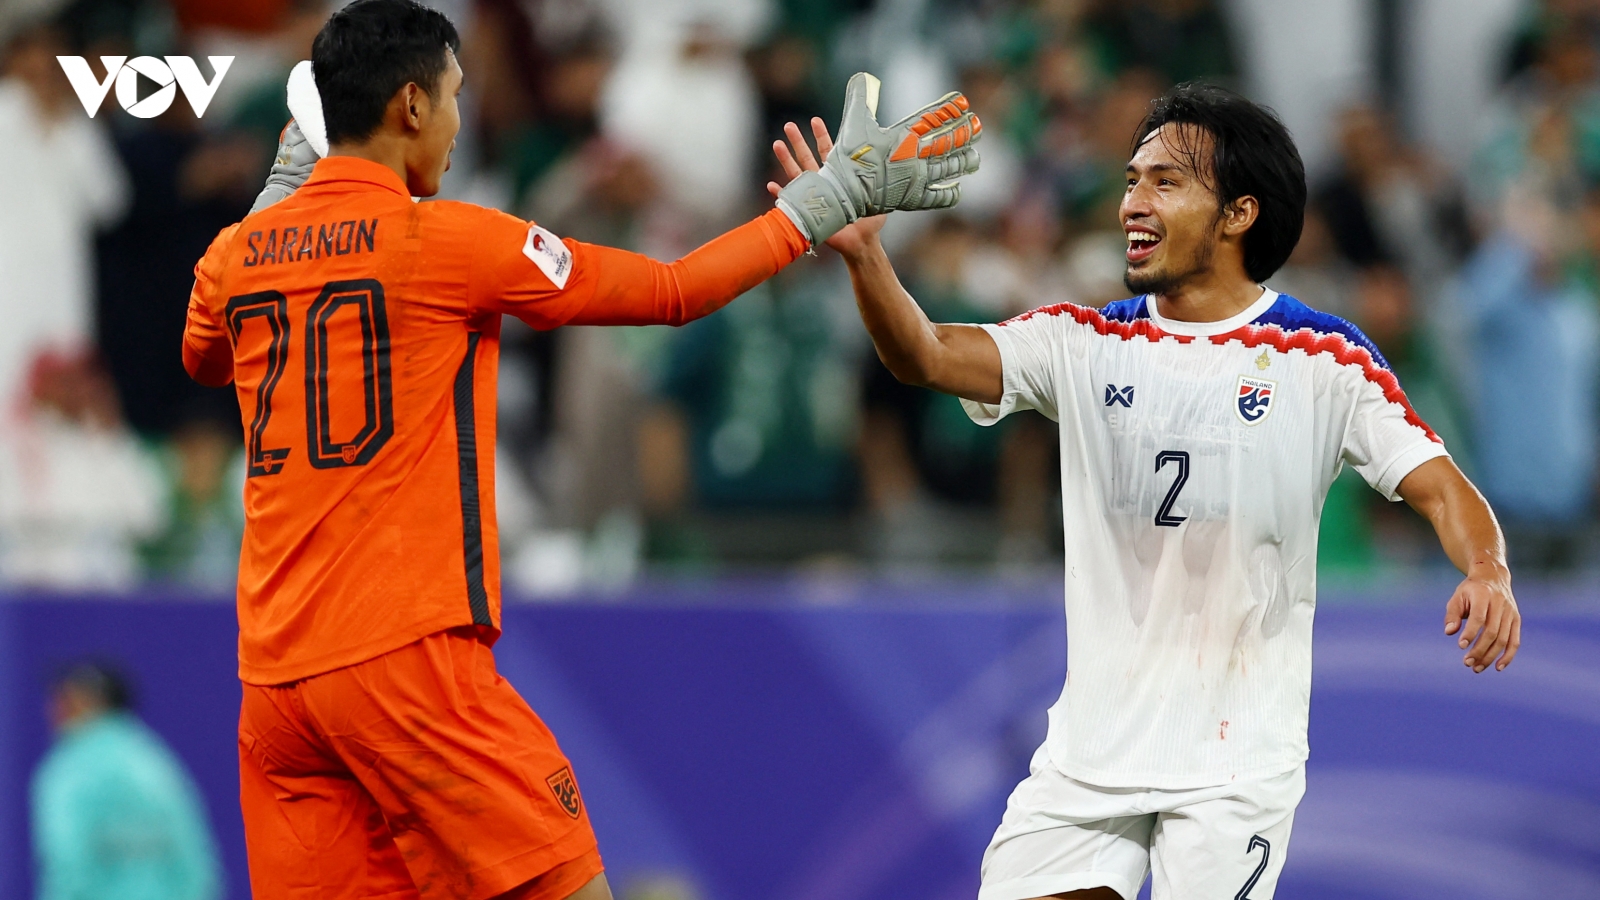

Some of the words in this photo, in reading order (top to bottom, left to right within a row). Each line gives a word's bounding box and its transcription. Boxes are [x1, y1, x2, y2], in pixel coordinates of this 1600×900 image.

[243, 218, 379, 267] SARANON
[224, 277, 395, 479] 20
[1241, 378, 1273, 390] THAILAND
[1154, 450, 1190, 527] 2
[1233, 833, 1271, 900] 2
